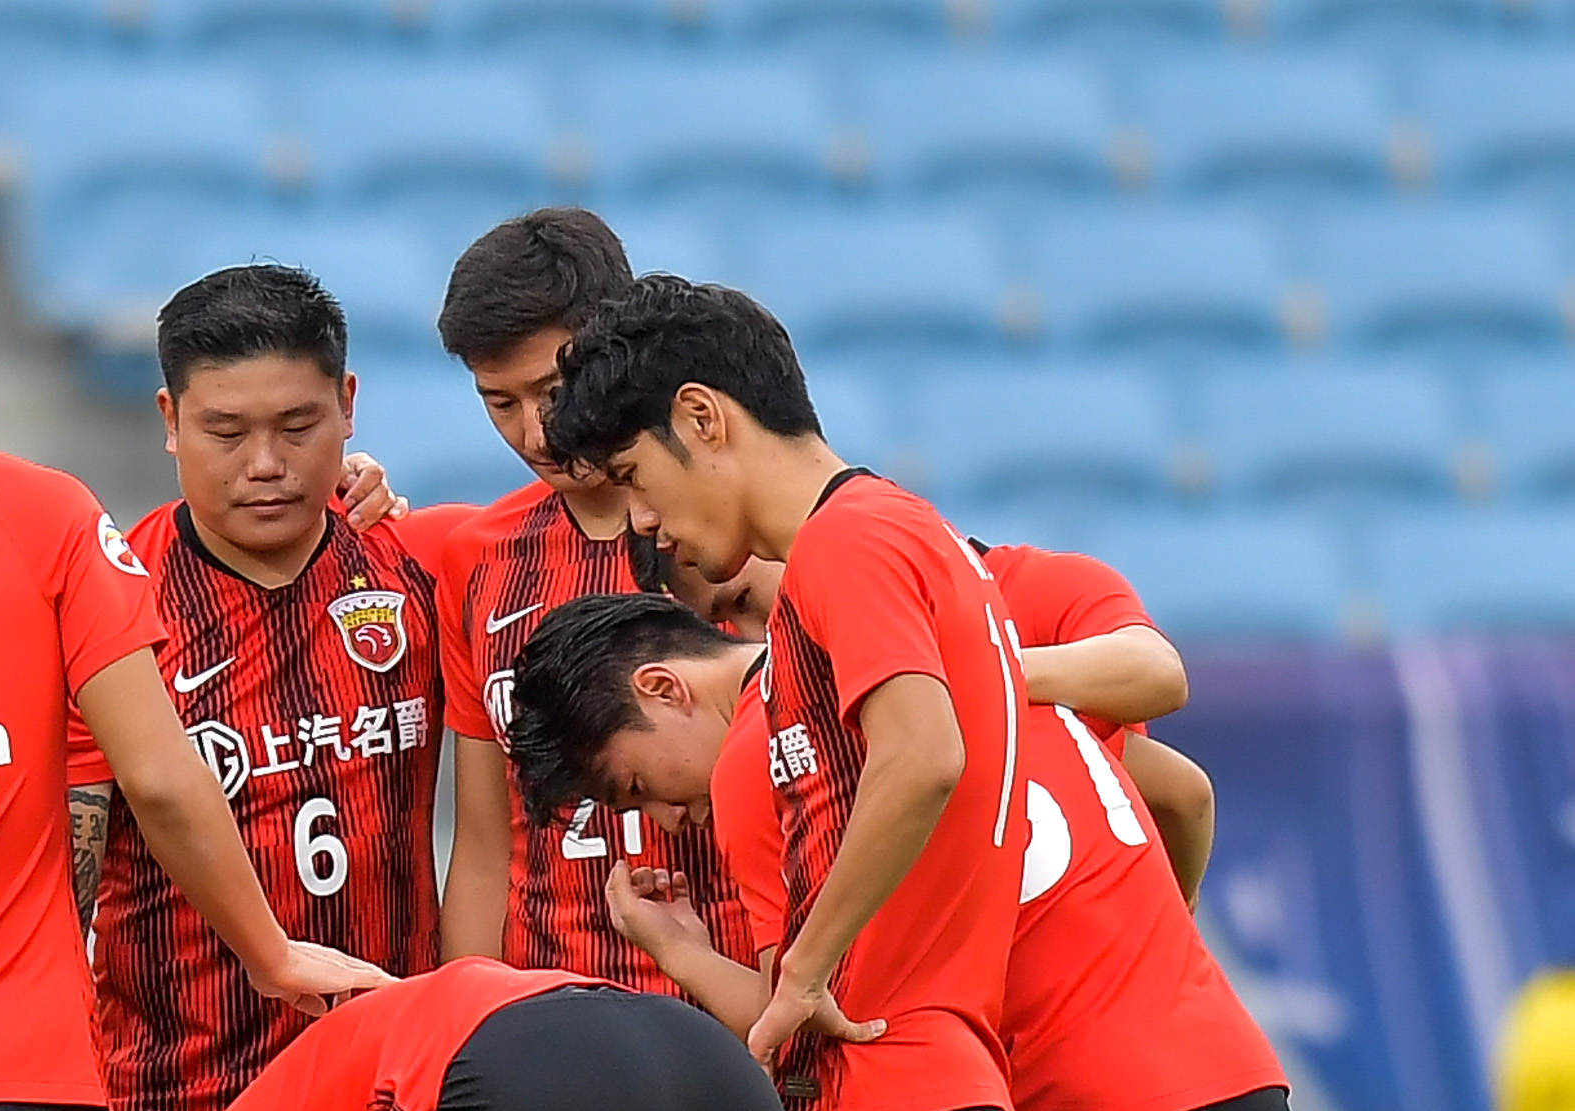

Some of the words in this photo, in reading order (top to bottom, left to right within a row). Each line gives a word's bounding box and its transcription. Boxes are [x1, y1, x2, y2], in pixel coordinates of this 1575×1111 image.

[252, 696, 429, 777] 上汽名爵
[294, 797, 348, 897] 6
